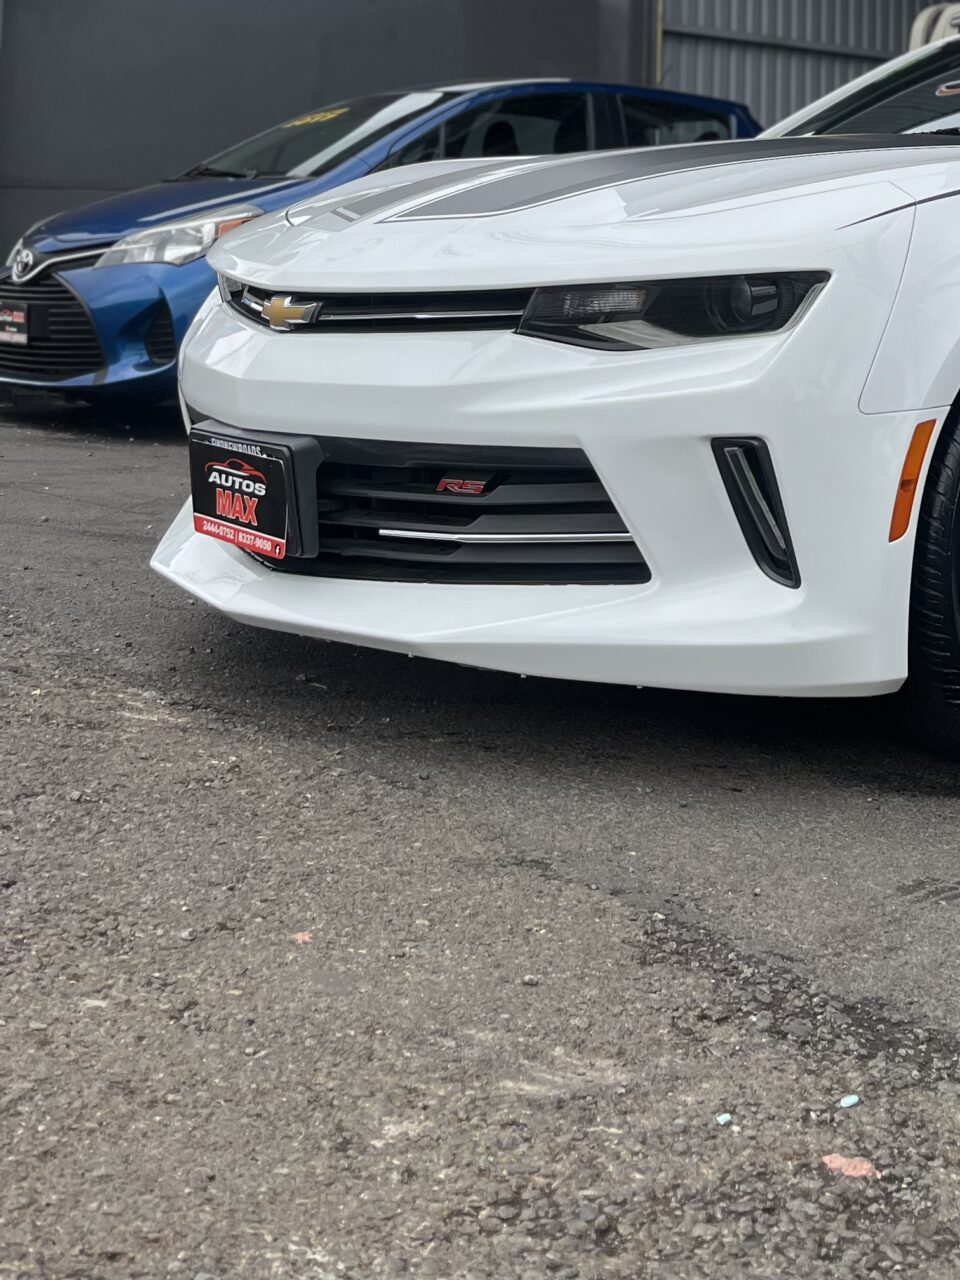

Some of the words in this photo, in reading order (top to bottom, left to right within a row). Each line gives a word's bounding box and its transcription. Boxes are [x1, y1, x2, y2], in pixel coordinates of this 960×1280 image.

[208, 471, 267, 496] AUTOS
[436, 478, 487, 494] RS
[216, 487, 259, 527] MAX
